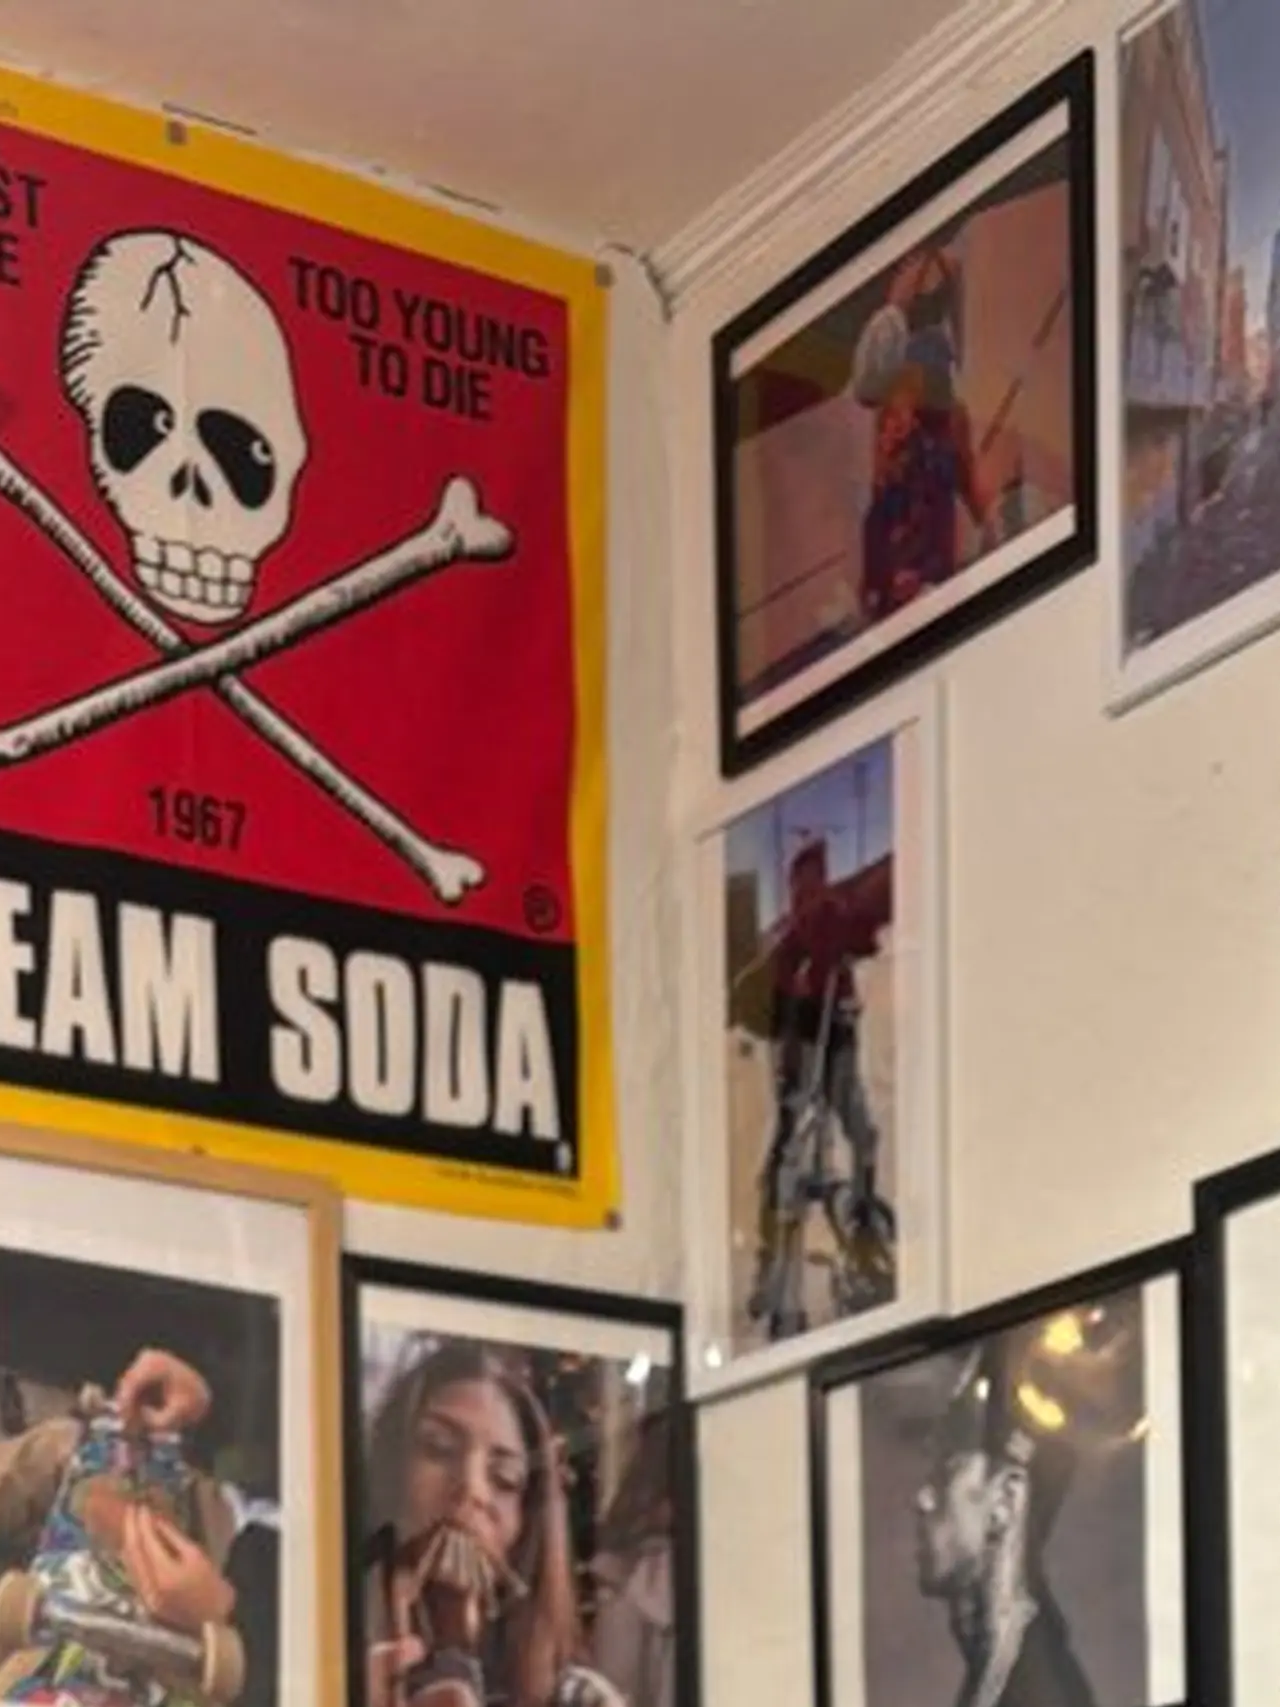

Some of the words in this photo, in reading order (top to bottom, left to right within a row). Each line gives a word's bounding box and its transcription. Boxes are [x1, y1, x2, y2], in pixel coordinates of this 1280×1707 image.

[286, 255, 381, 332] TOO
[393, 289, 551, 378] YOUNG
[348, 332, 408, 398] TO
[422, 356, 493, 422] DIE
[149, 786, 246, 854] 1967
[268, 935, 562, 1140] SODA
